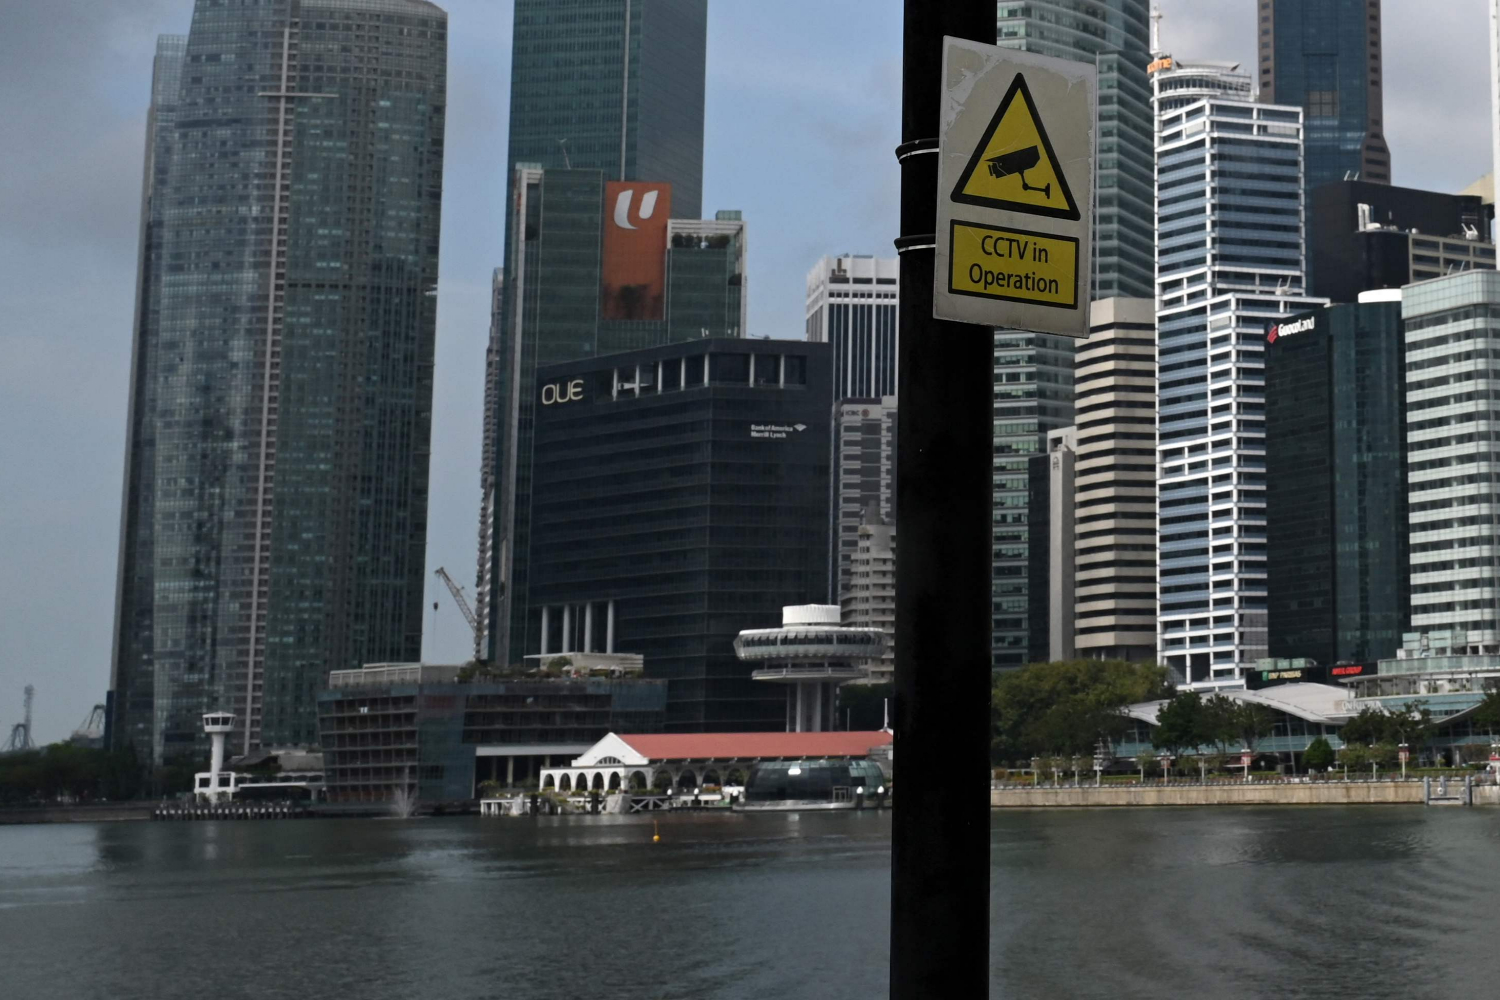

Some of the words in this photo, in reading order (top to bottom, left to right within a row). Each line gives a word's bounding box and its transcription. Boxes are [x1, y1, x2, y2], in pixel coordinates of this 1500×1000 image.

[981, 235, 1029, 260] CCTV
[1033, 242, 1049, 264] in
[968, 263, 1059, 295] Operation
[541, 379, 584, 405] OUE
